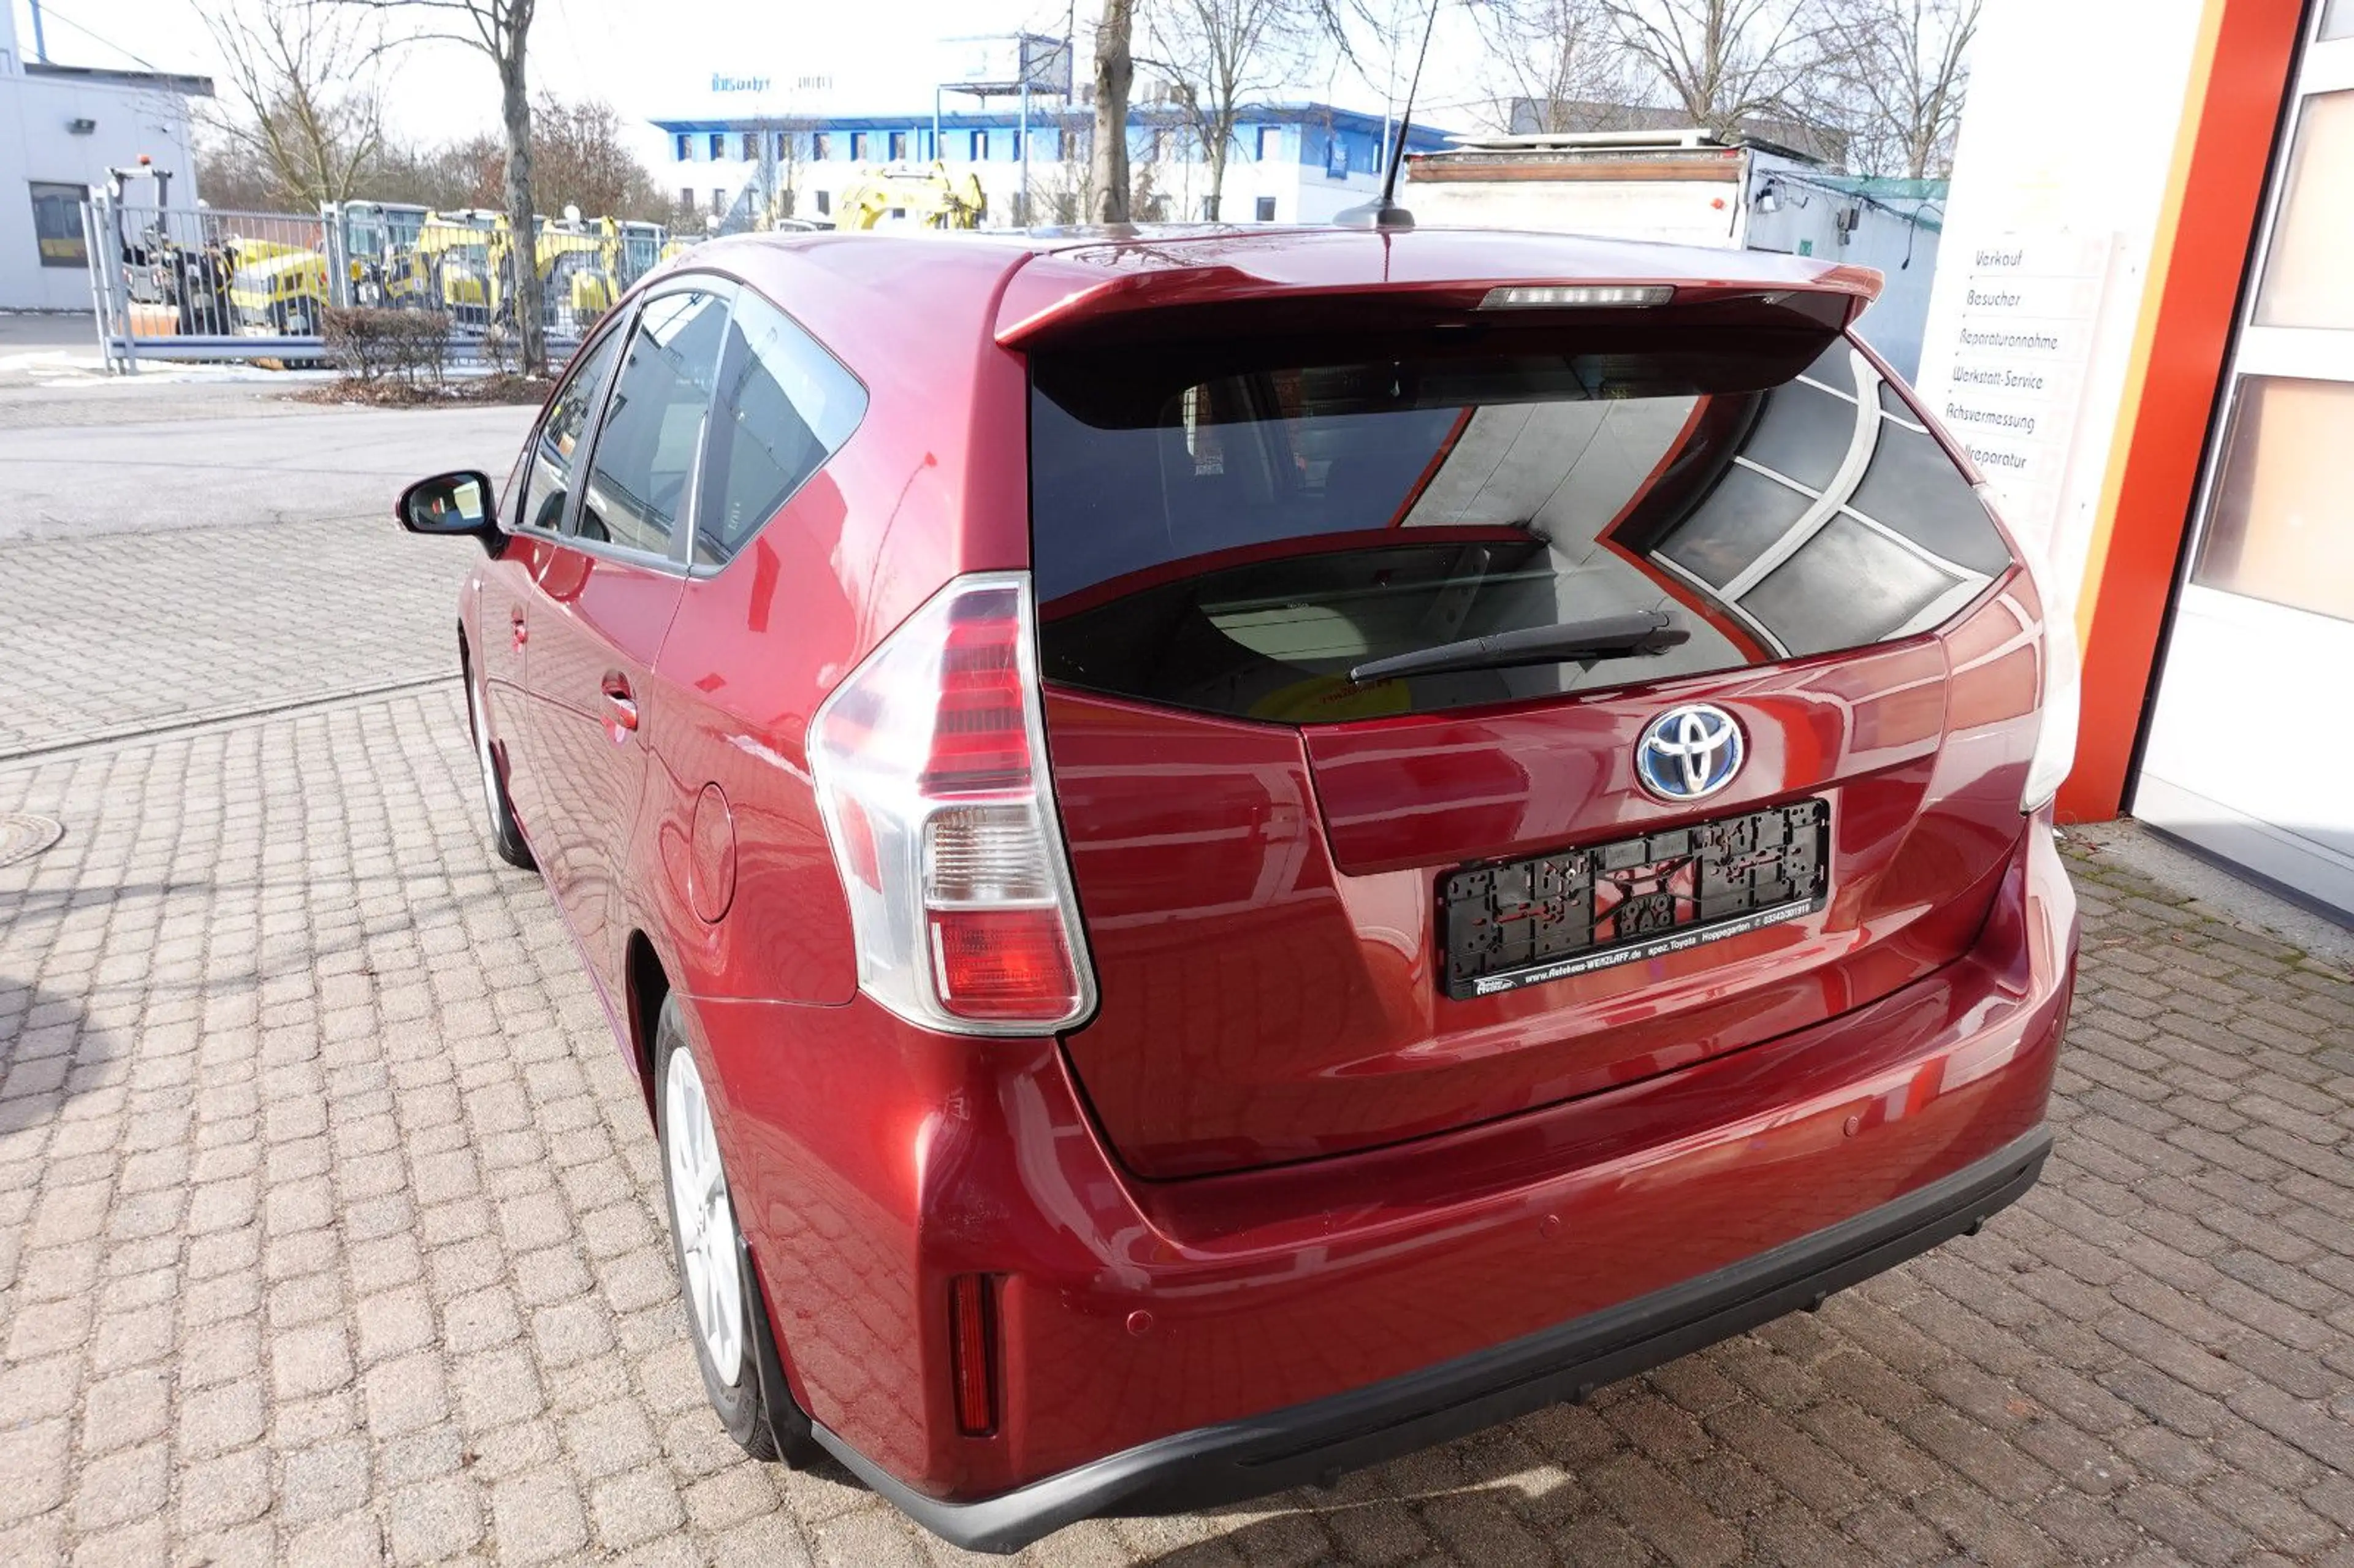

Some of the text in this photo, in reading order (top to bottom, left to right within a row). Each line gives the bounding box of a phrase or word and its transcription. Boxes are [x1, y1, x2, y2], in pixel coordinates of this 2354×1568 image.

[1976, 250, 2023, 266] Verkauf
[1967, 289, 2021, 306] Besucher
[1960, 327, 2059, 349] Reparaturannahme
[1953, 366, 2043, 389] Werkstatt-Service
[1946, 402, 2035, 435] Achsvermessung
[1670, 936, 1696, 951] Toyota
[1702, 922, 1750, 942] Hoppegarten
